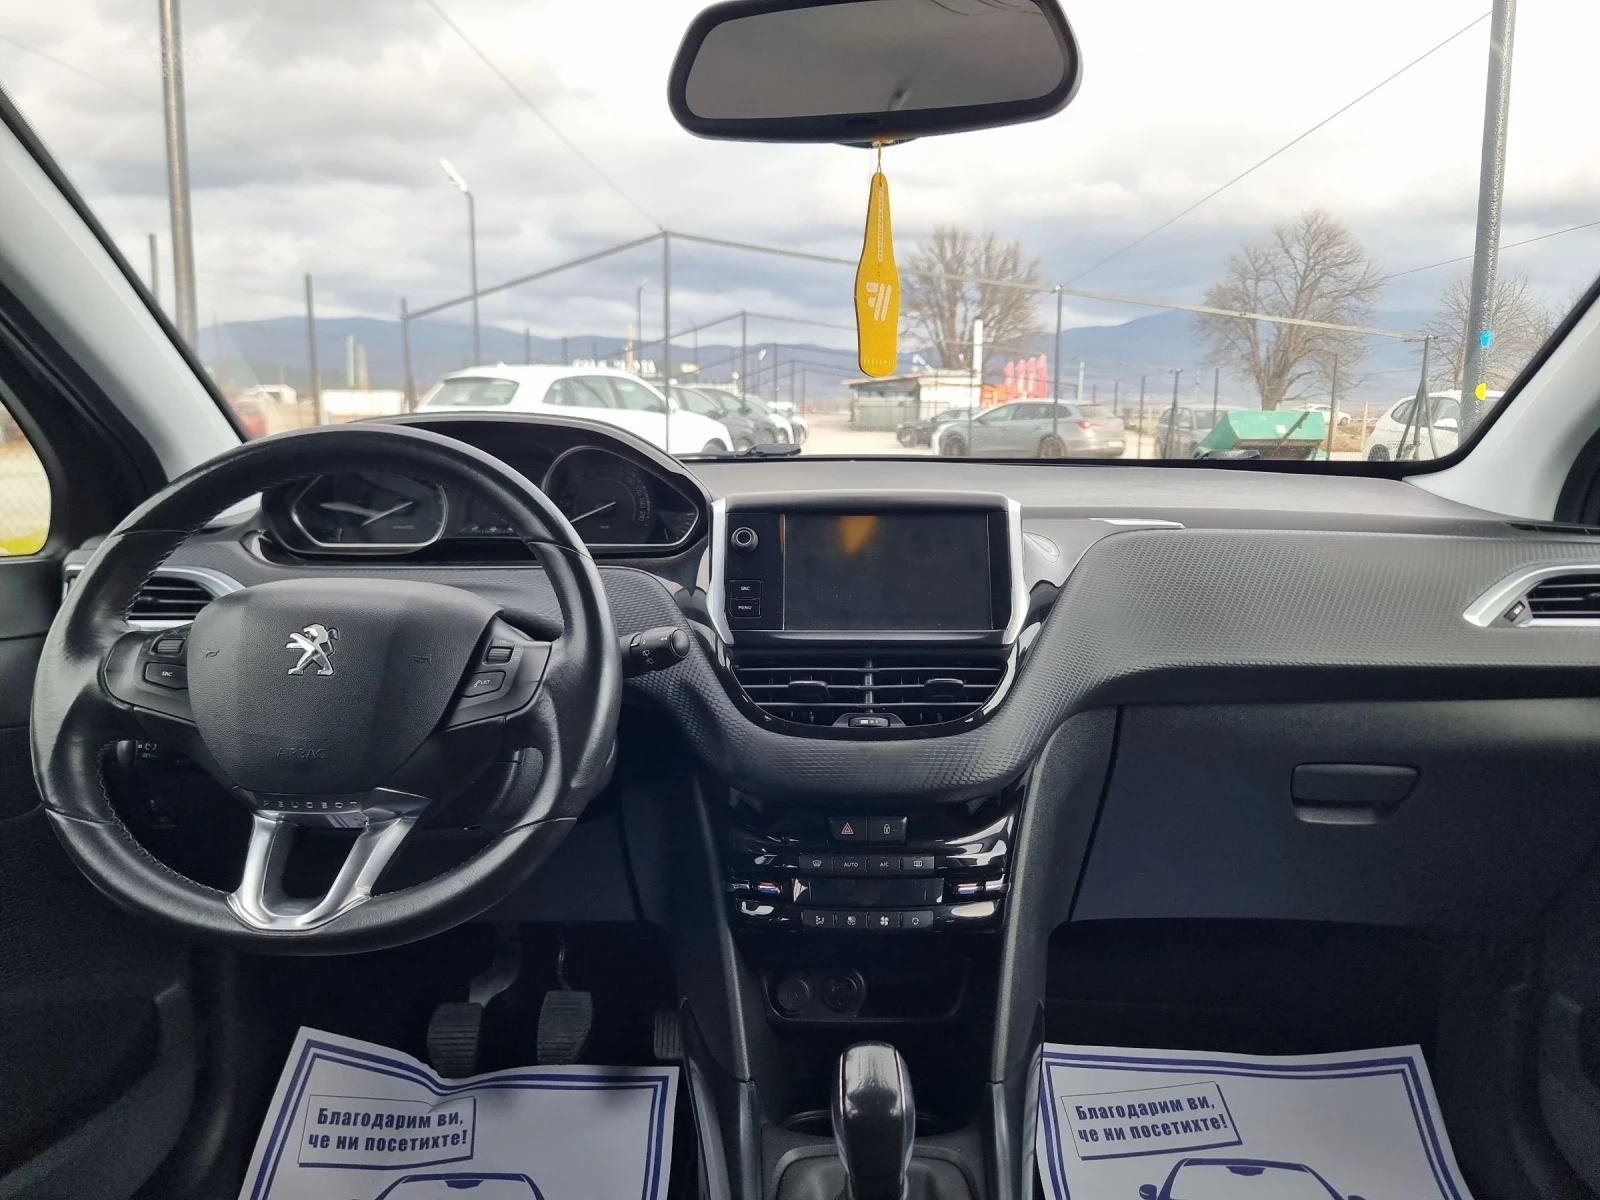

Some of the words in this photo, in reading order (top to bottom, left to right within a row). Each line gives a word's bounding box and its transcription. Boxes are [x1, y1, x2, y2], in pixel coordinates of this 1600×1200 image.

[317, 1107, 432, 1130] Благодарим
[437, 1111, 463, 1127] ви,
[1075, 1098, 1184, 1121] Благодарим
[1186, 1095, 1215, 1111] ви,
[1077, 1128, 1100, 1143] че
[1103, 1126, 1126, 1142] ни
[1129, 1113, 1228, 1140] посетихте!
[308, 1133, 331, 1149] че
[336, 1135, 359, 1151] ни
[364, 1129, 468, 1152] посетихте!
